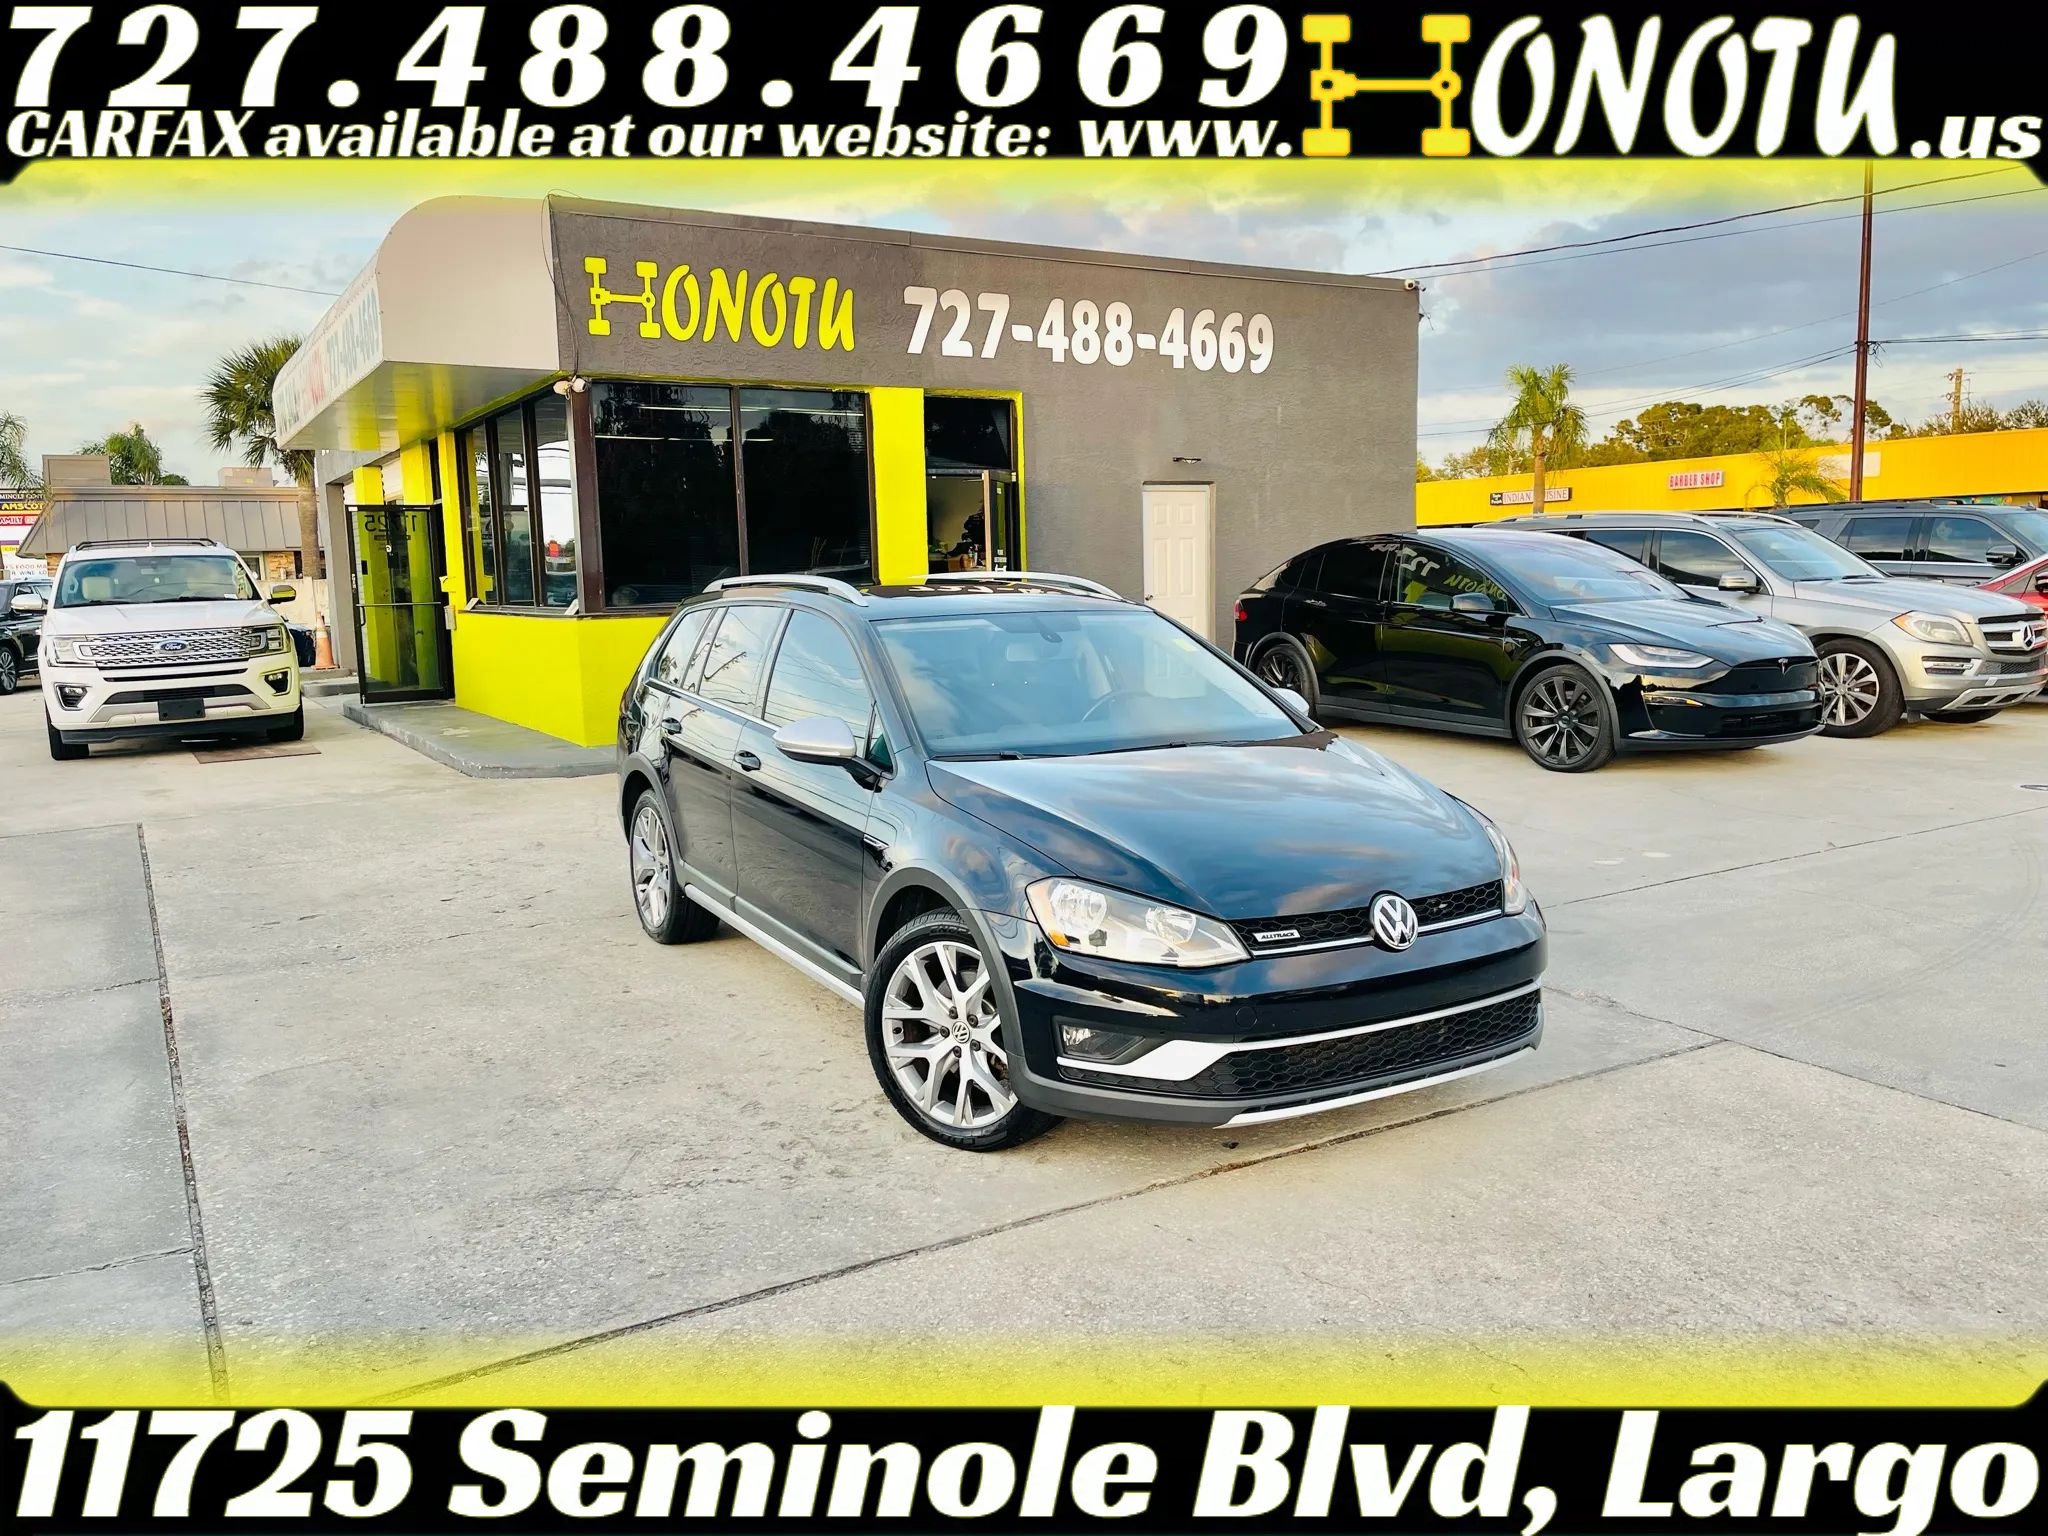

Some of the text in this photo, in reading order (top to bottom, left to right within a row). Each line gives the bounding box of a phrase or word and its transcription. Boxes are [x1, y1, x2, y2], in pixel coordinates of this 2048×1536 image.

[903, 285, 1274, 375] 727-488-4669
[1669, 471, 1721, 488] BARBER SHOP
[1503, 492, 1532, 503] INDIAN
